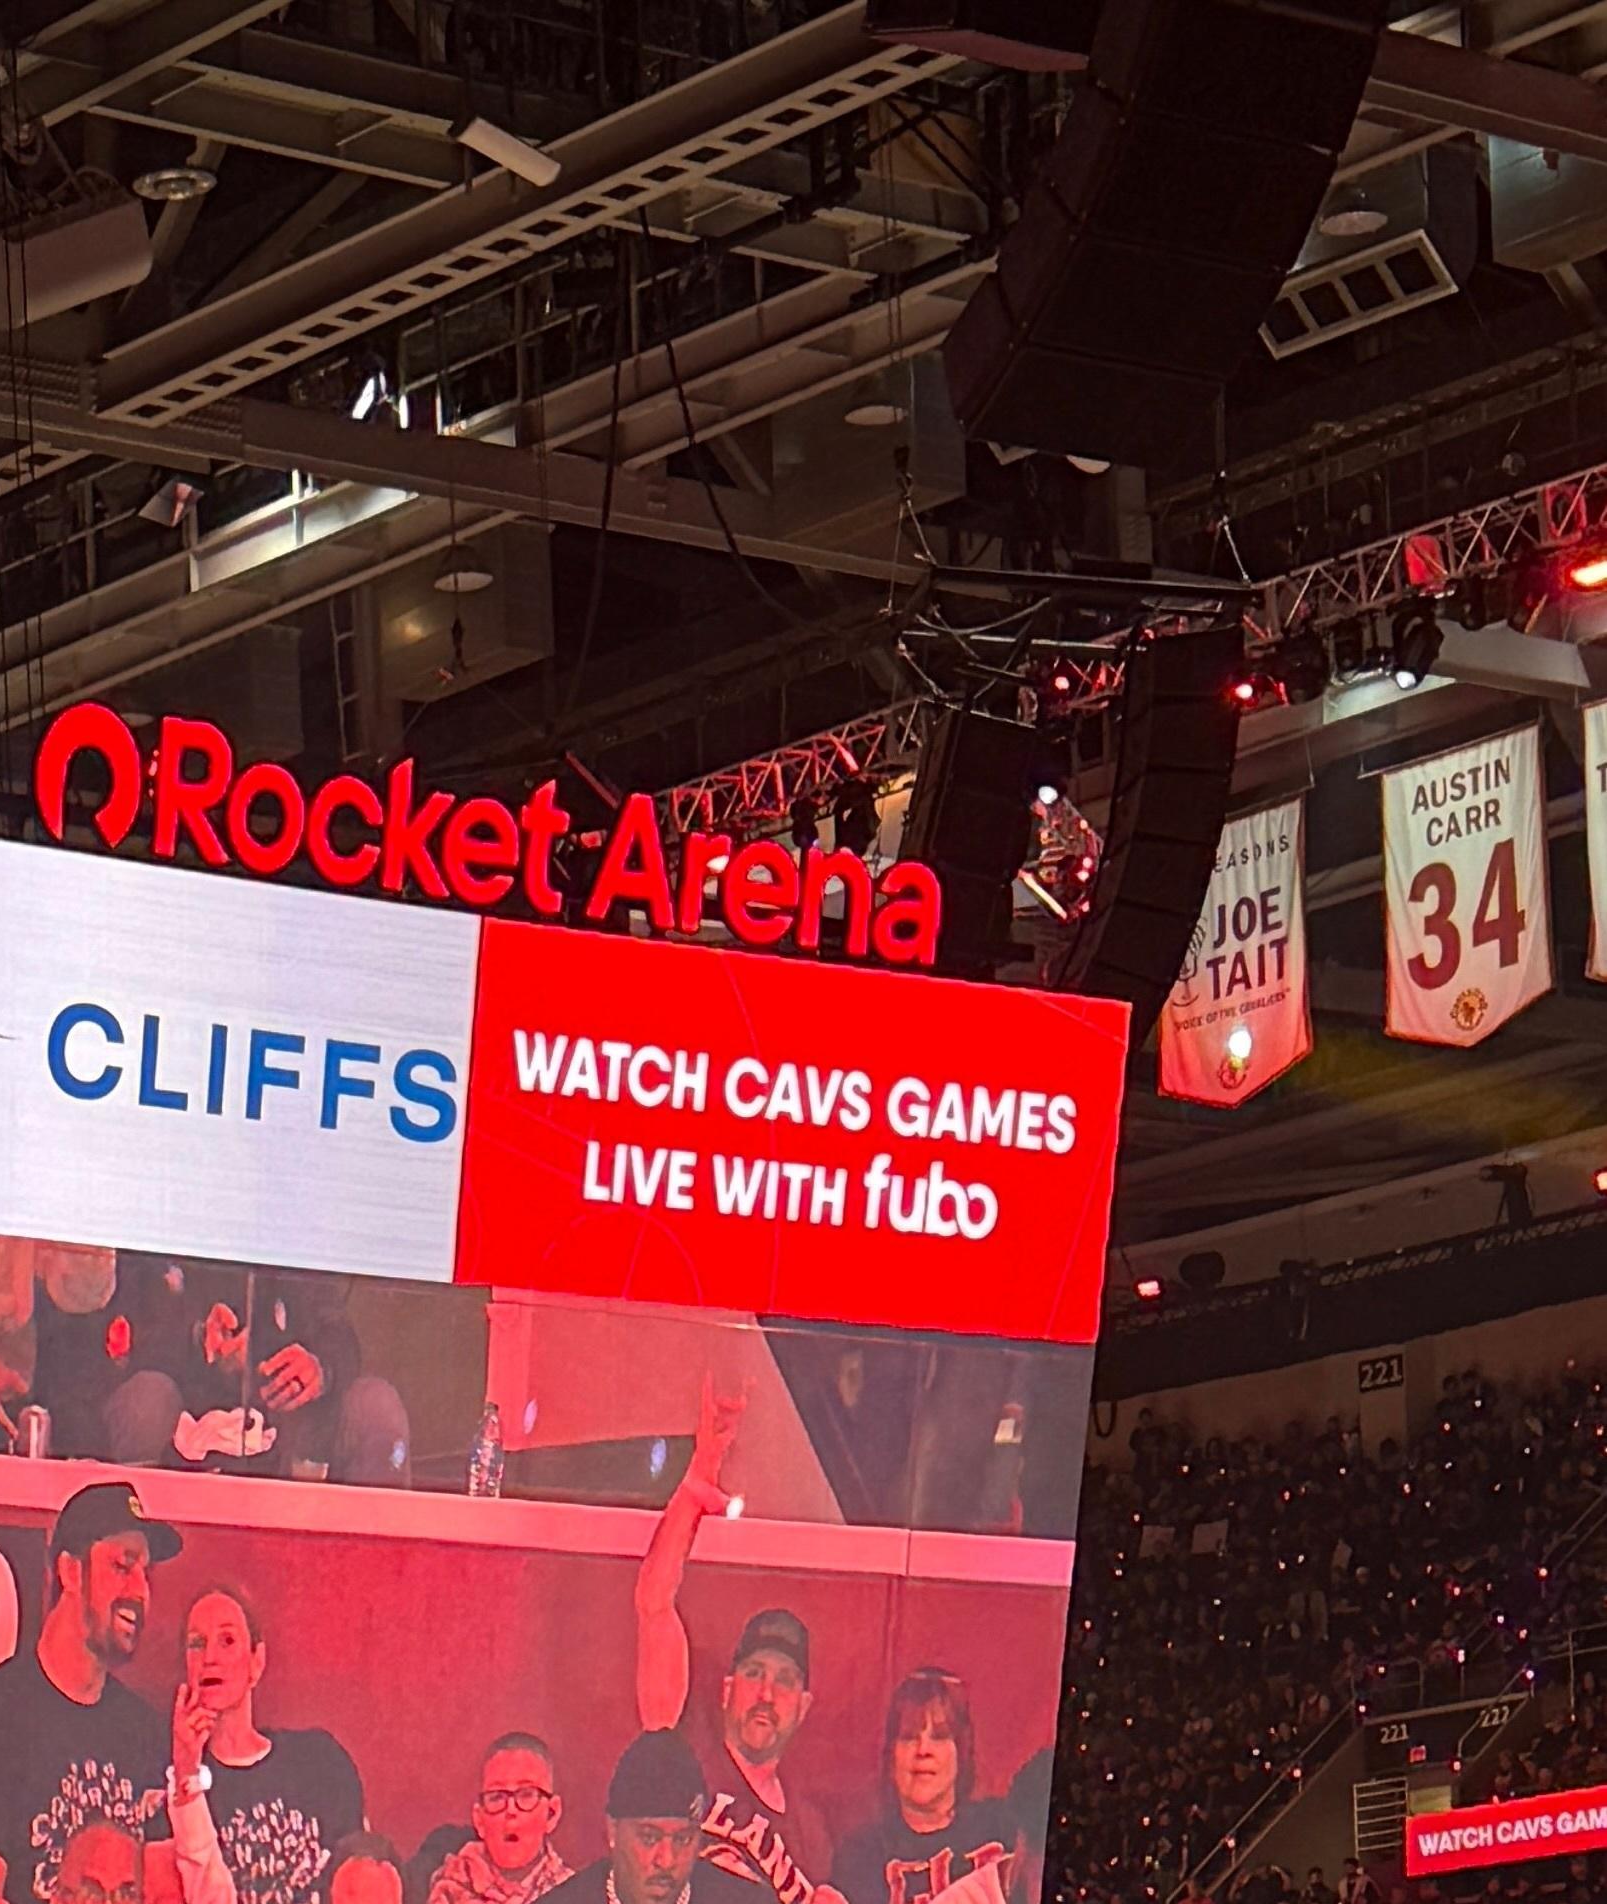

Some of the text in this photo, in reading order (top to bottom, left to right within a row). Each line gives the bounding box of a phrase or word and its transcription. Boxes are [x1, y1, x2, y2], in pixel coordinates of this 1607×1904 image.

[1411, 756, 1511, 815] AUSTIN
[152, 713, 944, 965] Rocket Arena
[1213, 834, 1289, 873] EASONS
[1426, 798, 1502, 847] CARR
[1212, 887, 1283, 948] JOE
[1406, 838, 1527, 992] 34
[1206, 937, 1289, 1001] TAIT
[45, 1002, 458, 1144] CLIFFS
[513, 1030, 1078, 1155] WATCH CAVS GAMES
[583, 1141, 997, 1241] LIVE WITH fubo
[1360, 1358, 1402, 1388] 221
[1419, 1805, 1607, 1858] WATCH CAVS GAM
